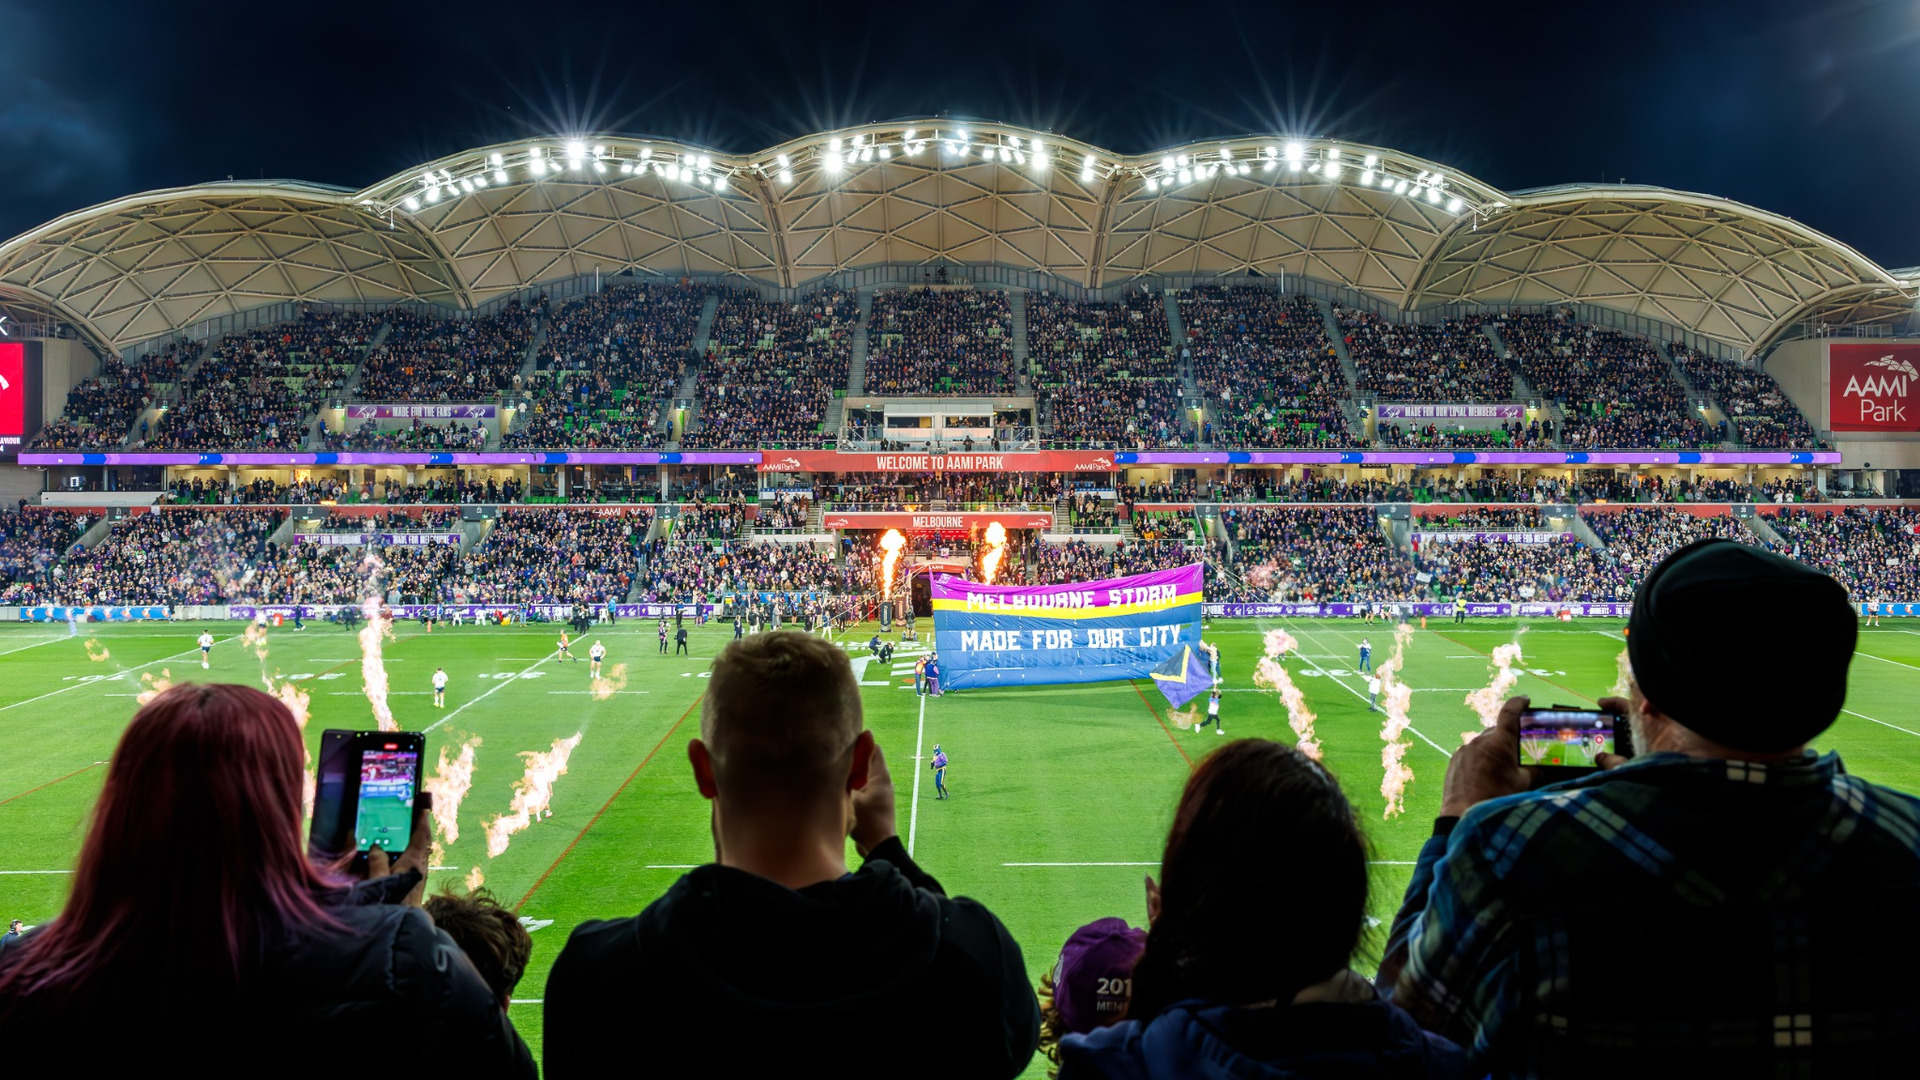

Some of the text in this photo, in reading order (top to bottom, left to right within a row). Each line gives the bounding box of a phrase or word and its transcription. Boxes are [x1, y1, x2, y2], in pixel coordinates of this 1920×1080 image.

[1842, 374, 1906, 397] AAMI
[393, 407, 451, 417] MADE FOR THE FANS
[1405, 406, 1496, 417] MADE FOR OUR LOYAL MEMBERS
[1860, 399, 1906, 422] Park
[877, 456, 1003, 470] WELCOME TO AAMI PARK
[599, 507, 620, 516] AAMI
[913, 516, 963, 527] MELBOURNE
[967, 584, 1177, 610] MELBOURNE STORM
[961, 624, 1181, 652] MADE FOR OUR CITY
[1096, 977, 1132, 997] 201
